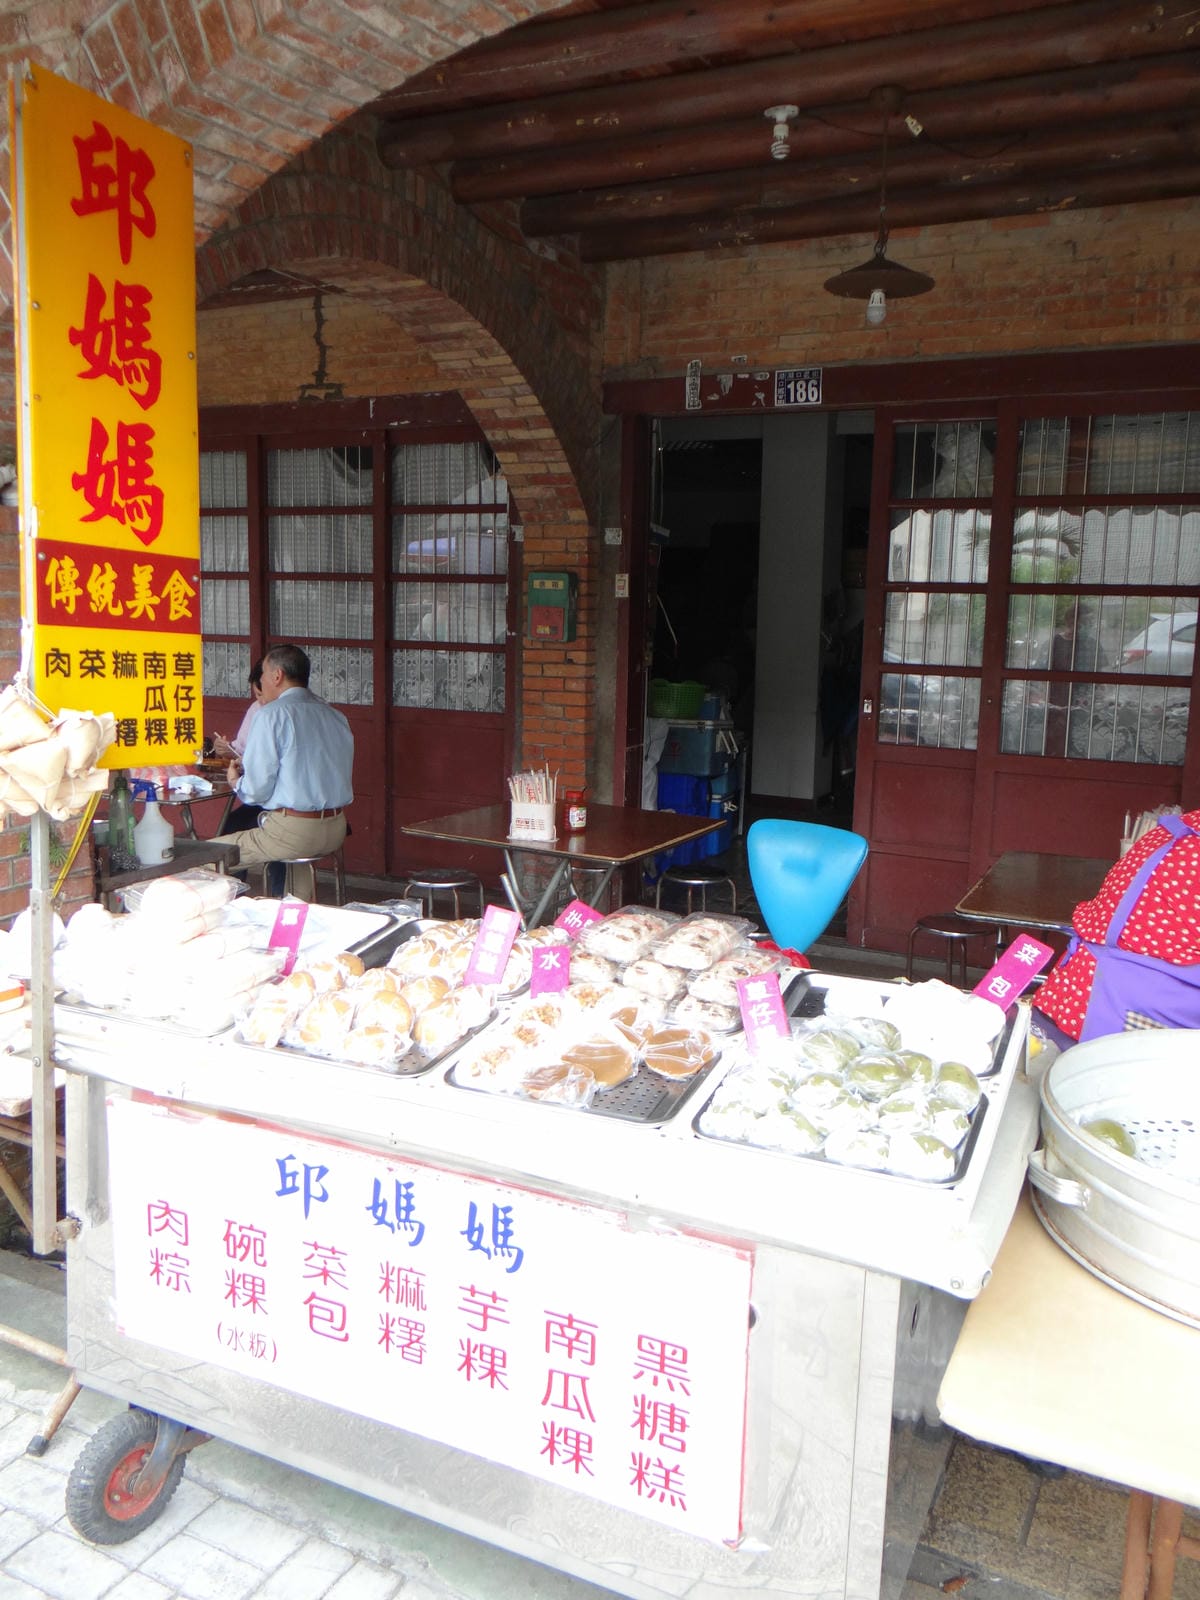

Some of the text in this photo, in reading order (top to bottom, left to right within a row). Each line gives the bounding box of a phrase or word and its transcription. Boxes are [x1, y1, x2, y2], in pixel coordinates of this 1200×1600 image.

[70, 120, 164, 546] 邱媽媽
[787, 379, 819, 403] 186
[45, 555, 196, 620] 傳統美食
[143, 652, 168, 746] 南瓜粿
[172, 653, 197, 745] 草仔粿
[539, 950, 561, 970] 水
[987, 942, 1042, 999] 菜包
[147, 1200, 191, 1293] 肉粽
[275, 1154, 525, 1274] 邱媽媽
[222, 1219, 269, 1315] 碗粿
[302, 1241, 349, 1343] 菜包
[457, 1284, 510, 1391] 芋粿
[540, 1310, 599, 1477] 南瓜粿
[629, 1333, 691, 1512] 黑糖糕
